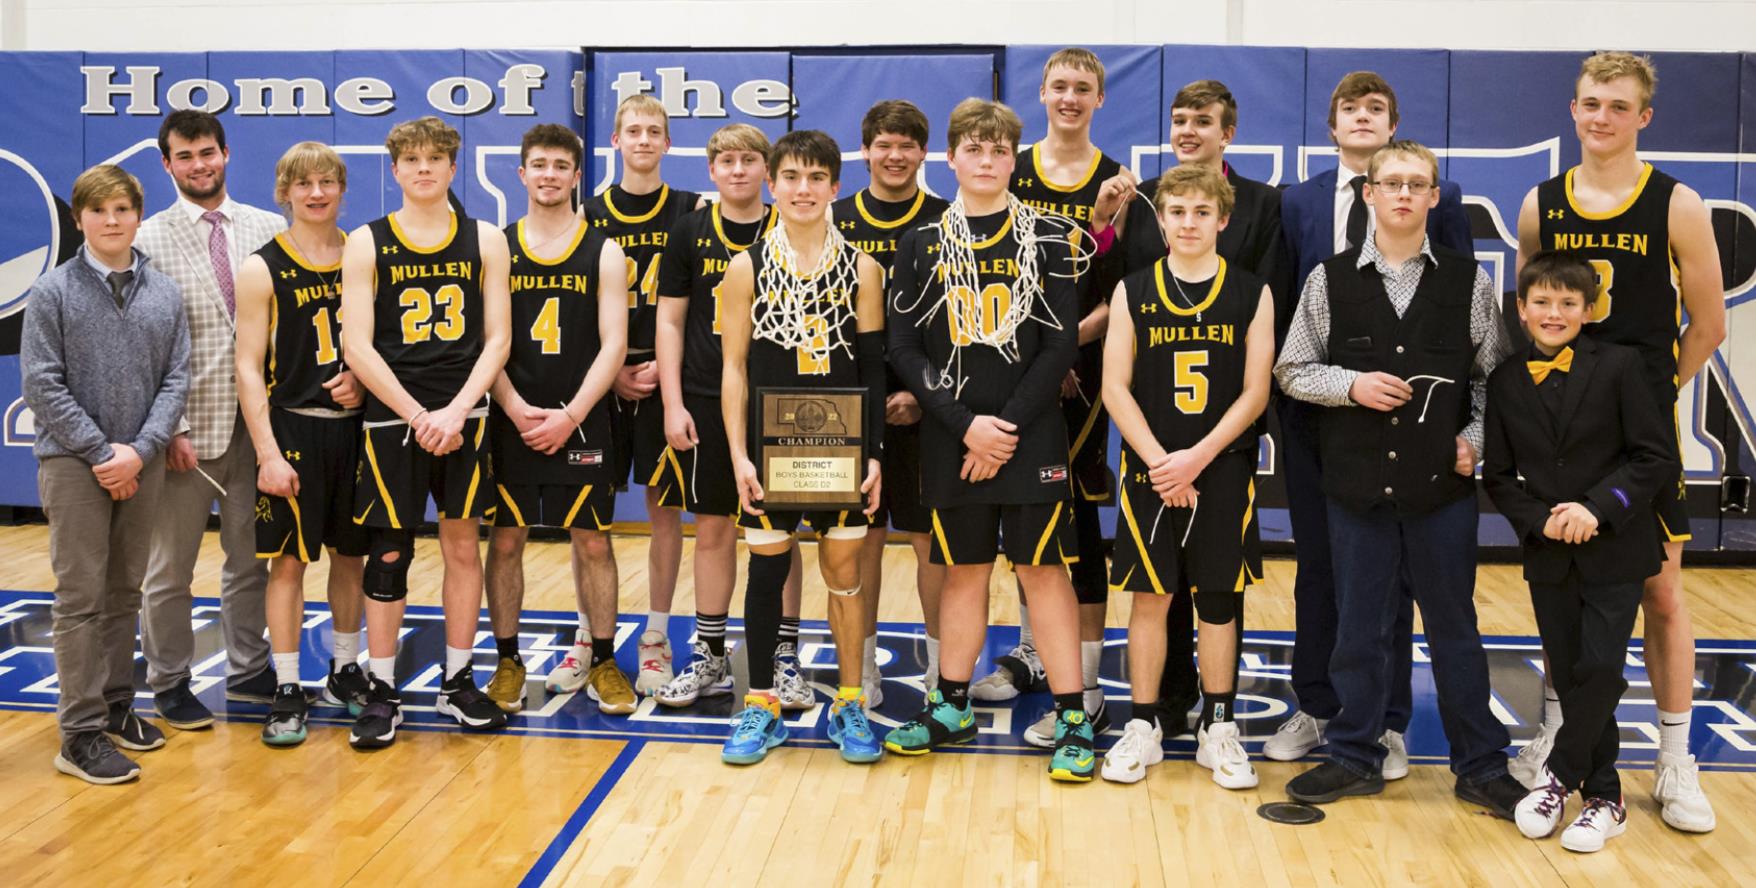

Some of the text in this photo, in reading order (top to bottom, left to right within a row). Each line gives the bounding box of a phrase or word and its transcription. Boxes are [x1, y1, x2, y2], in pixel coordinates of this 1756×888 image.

[80, 64, 799, 118] Home of the
[609, 231, 669, 249] ULLE
[1554, 233, 1648, 256] MULLEN
[390, 261, 472, 285] MULLEN
[510, 274, 588, 295] MULLEN
[399, 284, 466, 344] 23
[530, 296, 562, 355] 4
[946, 282, 1013, 347] 00
[312, 306, 344, 366] 1
[797, 313, 831, 375] 2
[1148, 324, 1235, 348] MULLEN
[1174, 350, 1209, 415] 5
[778, 437, 846, 447] CHAMPION
[775, 471, 848, 479] BOYS BASKETBALL
[792, 461, 833, 470] DISTRICT
[793, 481, 819, 489] CLASS
